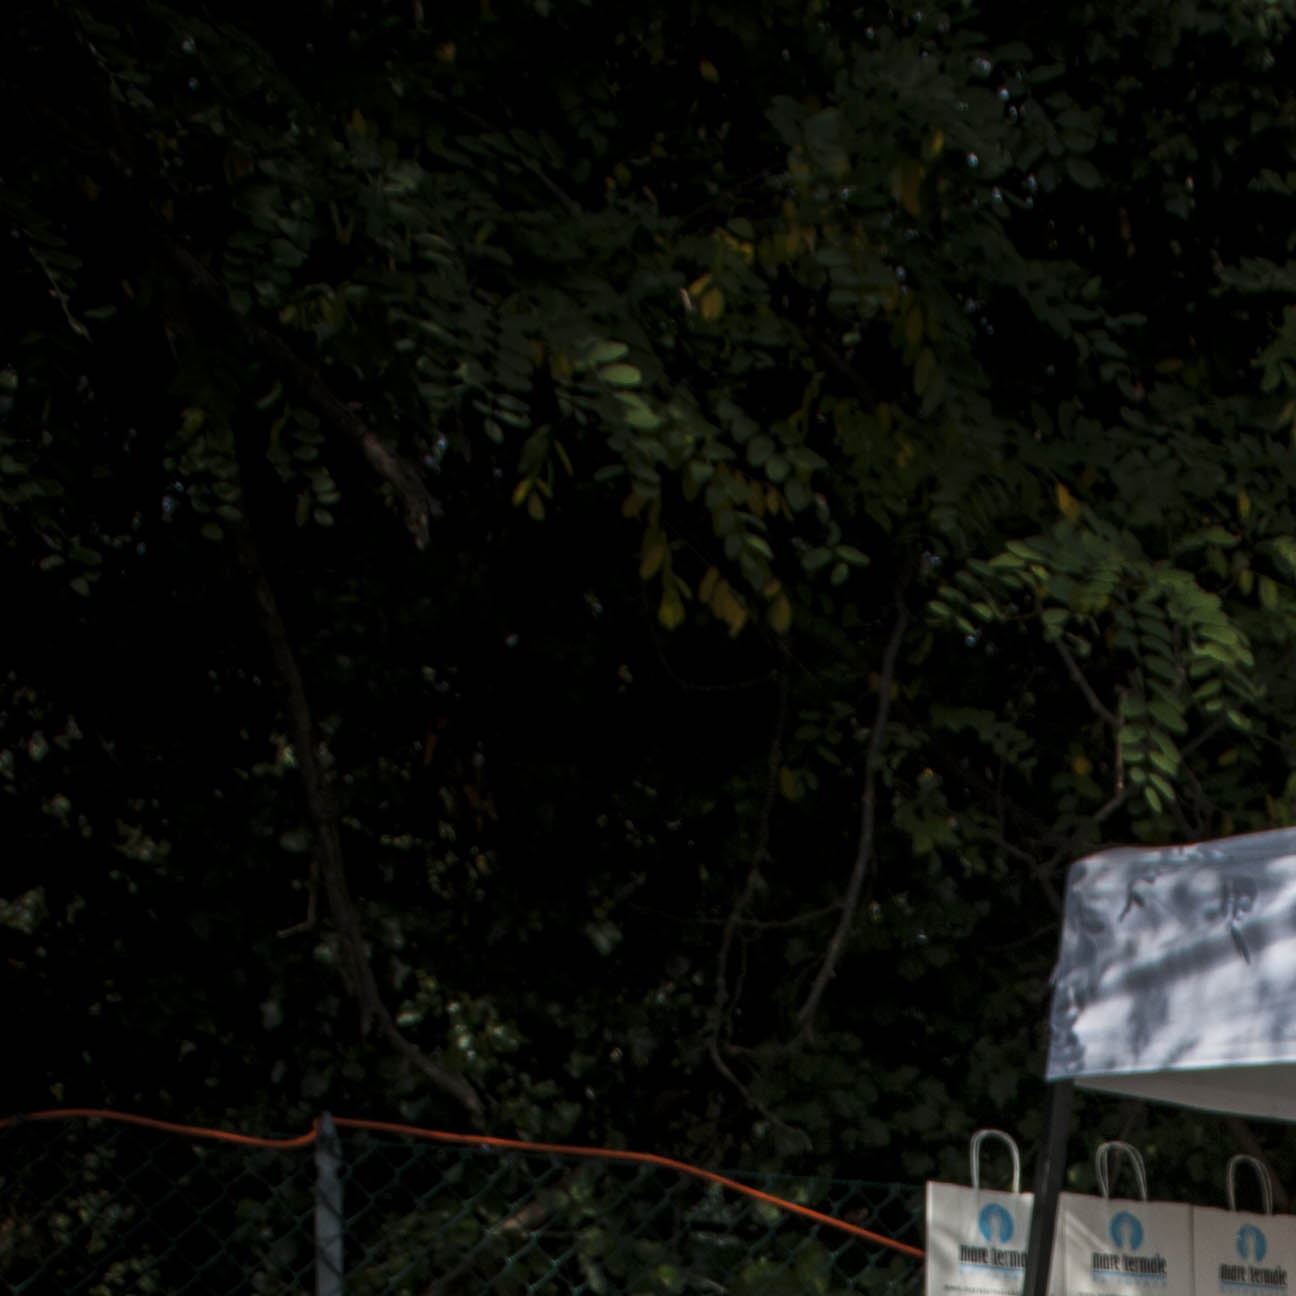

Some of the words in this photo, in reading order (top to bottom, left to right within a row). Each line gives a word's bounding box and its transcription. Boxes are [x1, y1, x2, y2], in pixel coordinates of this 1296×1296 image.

[992, 1247, 1028, 1268] terma
[1092, 1252, 1121, 1271] mare
[1122, 1252, 1168, 1274] termale
[1220, 1263, 1247, 1282] mare
[1248, 1265, 1288, 1286] termale
